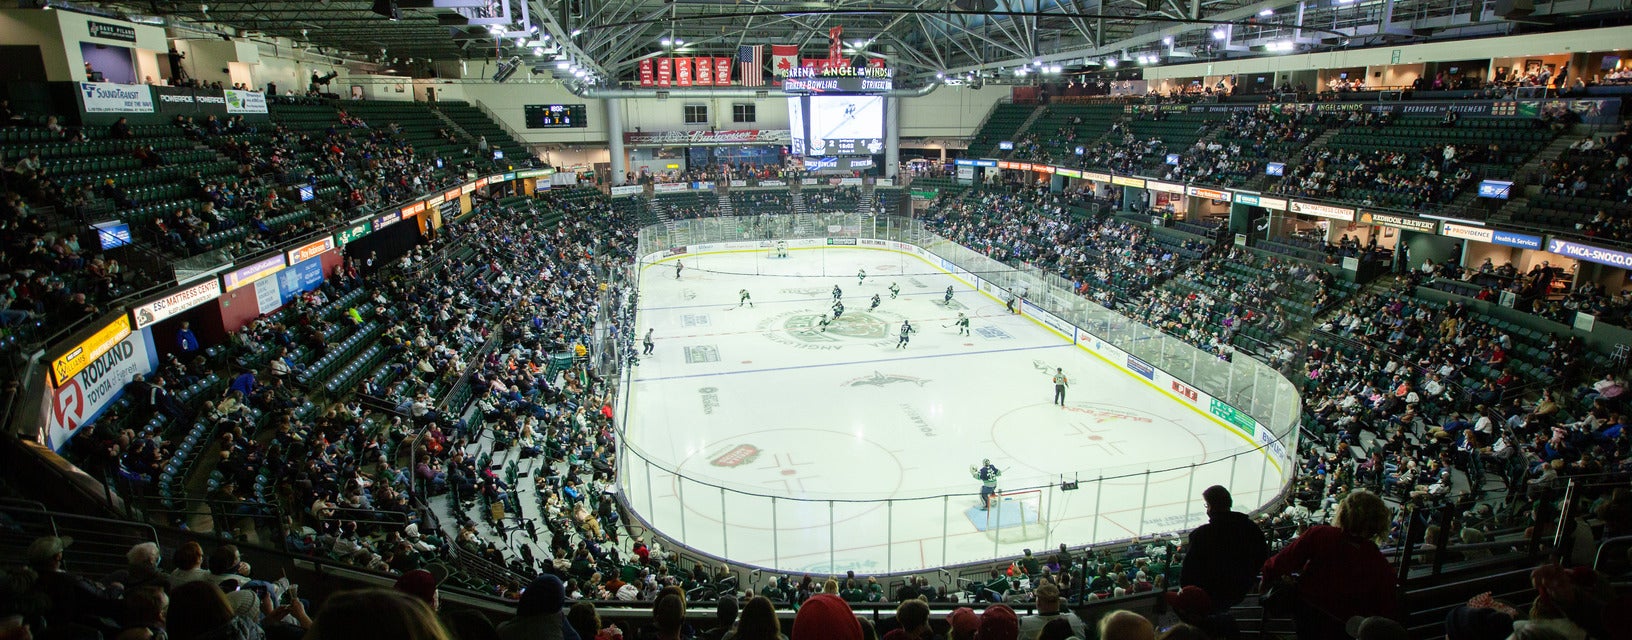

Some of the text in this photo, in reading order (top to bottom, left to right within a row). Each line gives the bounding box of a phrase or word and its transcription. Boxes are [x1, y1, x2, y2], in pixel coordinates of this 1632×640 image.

[823, 66, 858, 77] ANGEL
[864, 66, 888, 78] WINDS
[807, 80, 838, 90] BOWLING
[1341, 103, 1363, 111] WINDS
[1372, 214, 1402, 225] REDHOOK
[1402, 218, 1435, 229] BREWERY
[1452, 227, 1490, 239] PROVIDENCE
[1494, 235, 1511, 243] Health
[1517, 238, 1538, 247] Services
[301, 249, 309, 259] Roy
[153, 280, 219, 312] ESC MATTRESS CENTER
[81, 340, 133, 391] RODLAND
[87, 379, 112, 406] TOYOTA
[116, 361, 138, 382] Everett
